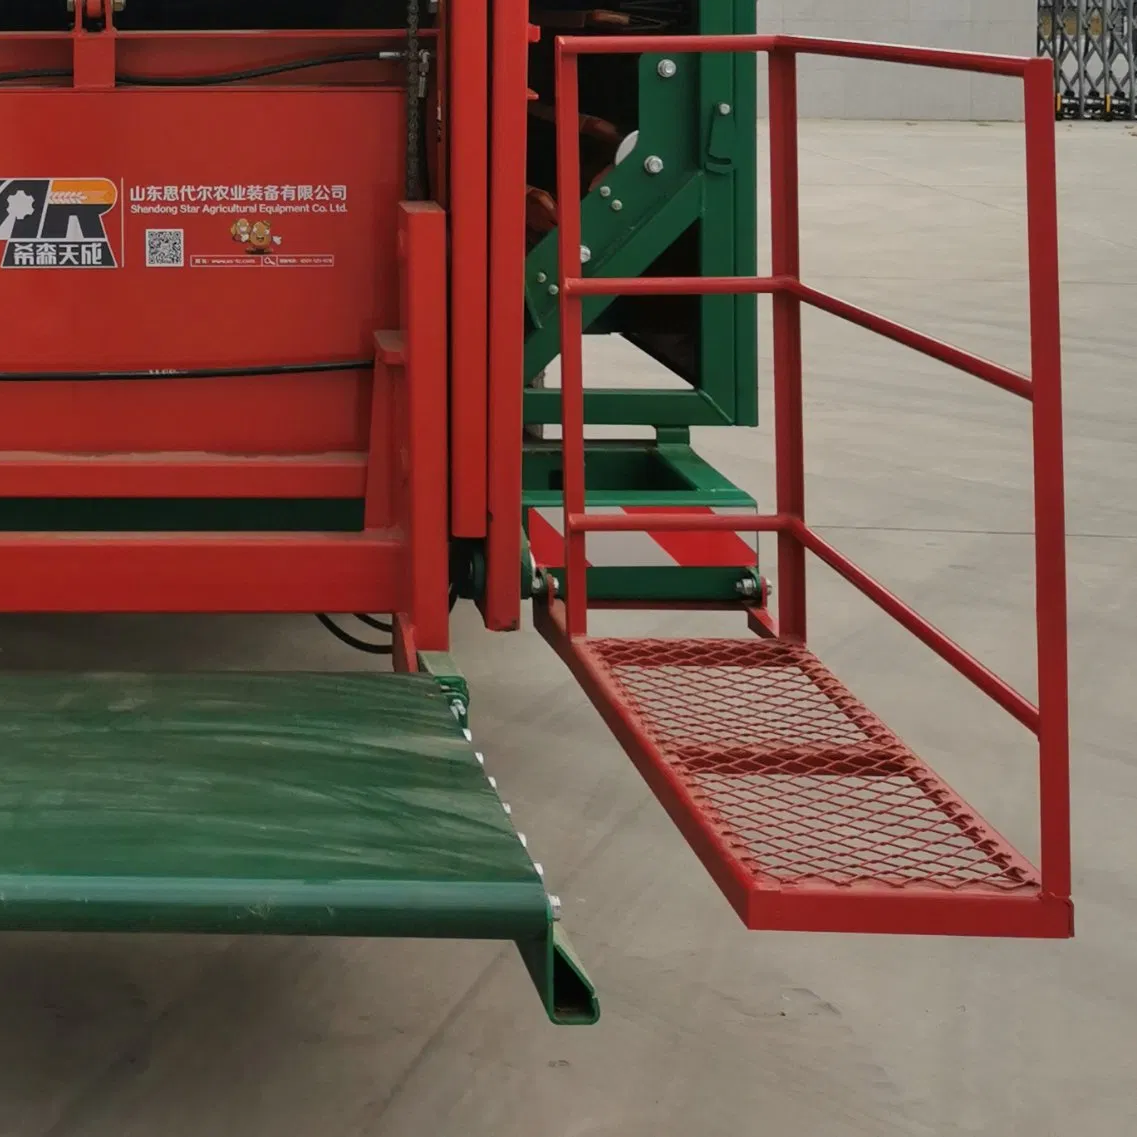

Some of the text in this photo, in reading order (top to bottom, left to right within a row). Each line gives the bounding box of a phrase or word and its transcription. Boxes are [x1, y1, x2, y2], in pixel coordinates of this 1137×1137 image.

[129, 184, 348, 202] 山东思代尔农业装备有限公司
[130, 203, 178, 215] Shandong
[179, 203, 200, 214] Star
[202, 203, 257, 215] Agricultural
[260, 202, 310, 215] Equipment
[329, 202, 348, 213] Ltd.
[13, 242, 103, 266] 希森天成
